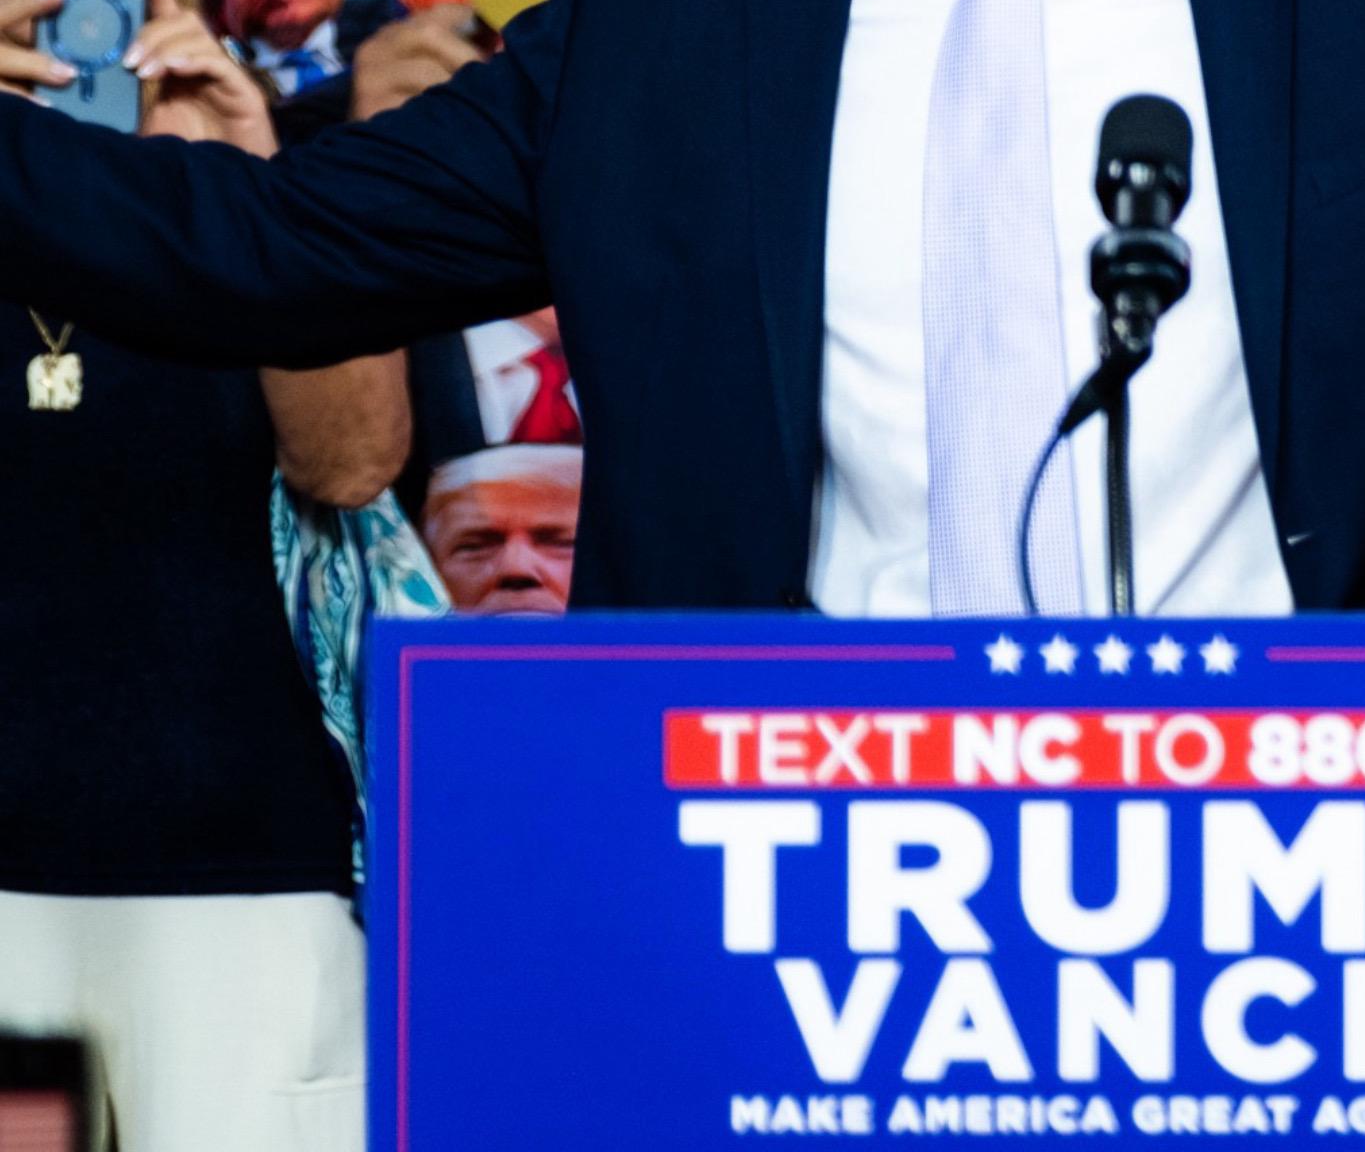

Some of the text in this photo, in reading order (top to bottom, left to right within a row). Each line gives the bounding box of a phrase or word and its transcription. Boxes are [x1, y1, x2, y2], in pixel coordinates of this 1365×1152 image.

[701, 714, 930, 786] TEXT
[952, 714, 1083, 786] NC
[1102, 714, 1227, 786] TO
[729, 1094, 873, 1135] MAKE
[886, 1094, 1118, 1135] AMERICA
[1130, 1094, 1299, 1135] GREAT
